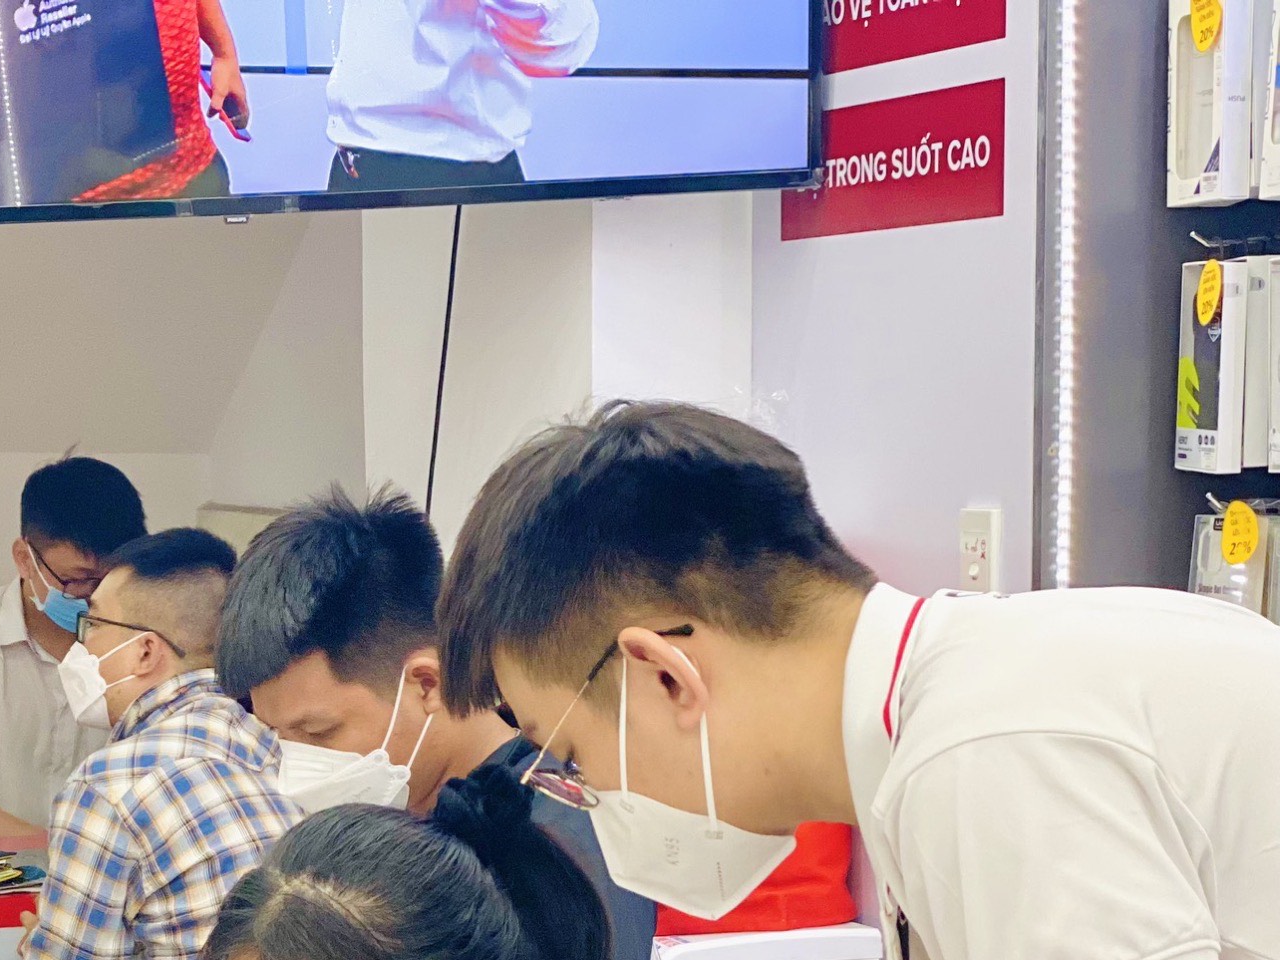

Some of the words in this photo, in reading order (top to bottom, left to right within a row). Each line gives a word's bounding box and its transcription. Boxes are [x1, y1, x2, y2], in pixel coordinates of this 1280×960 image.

[825, 151, 888, 188] TRONG
[891, 132, 944, 180] SUỐT
[947, 135, 991, 172] CAO
